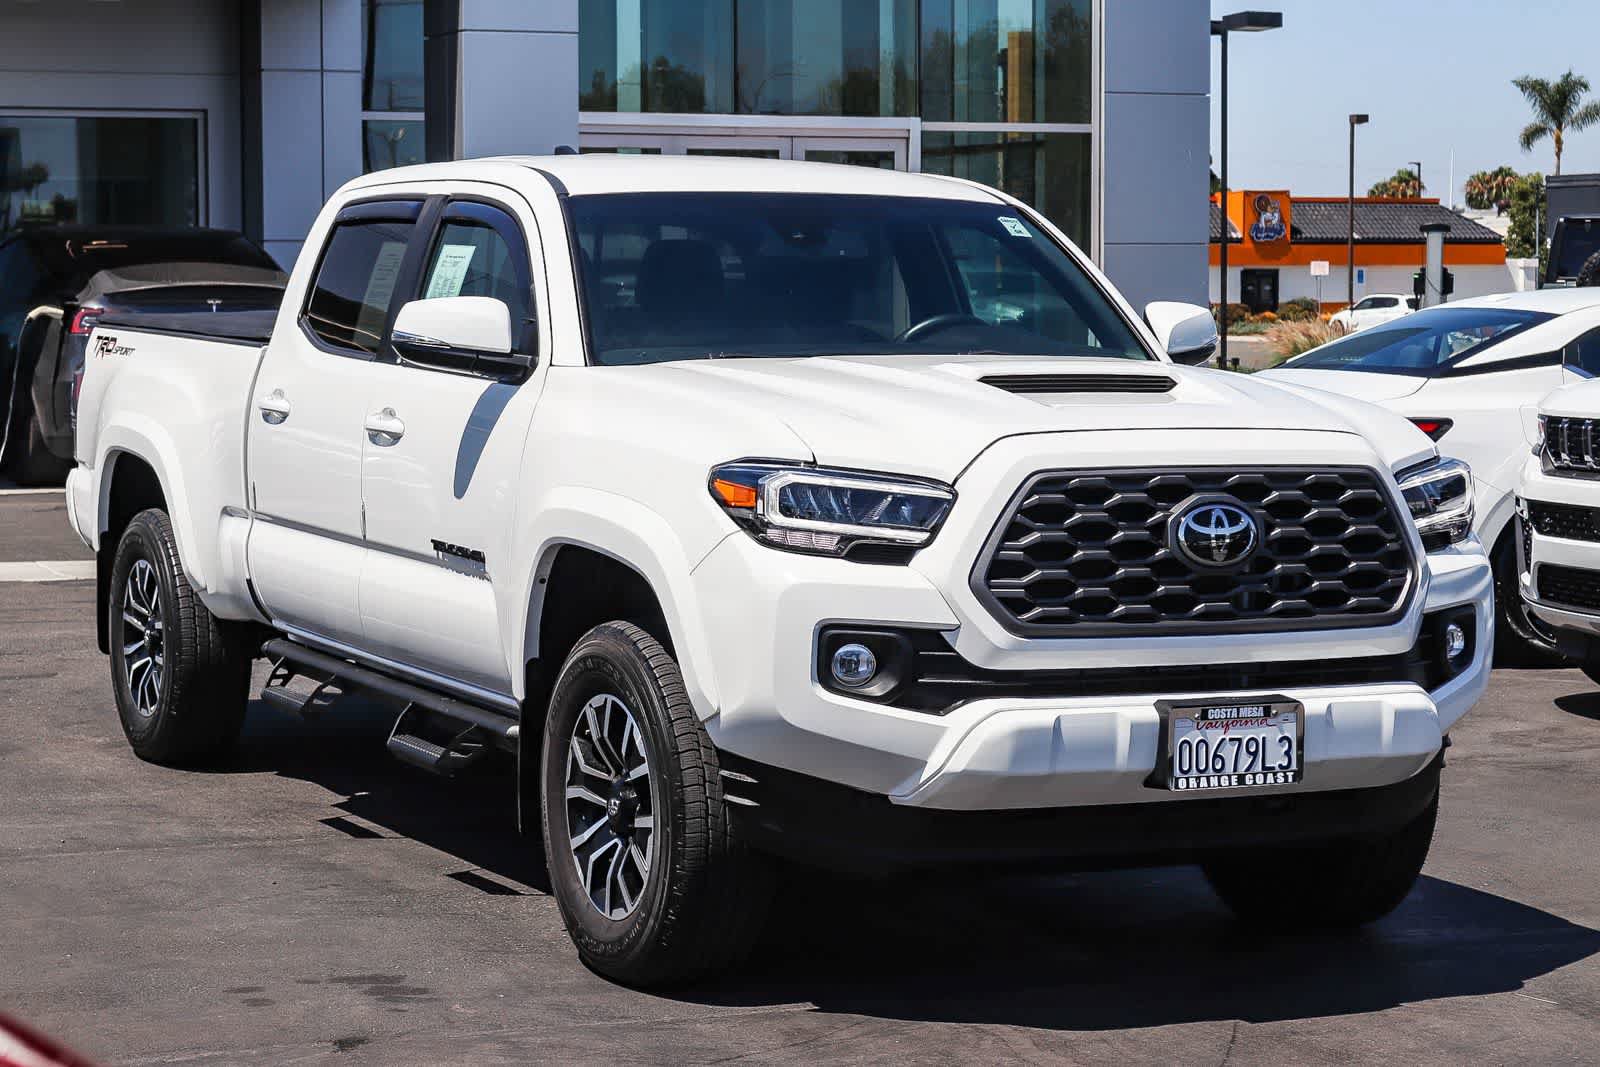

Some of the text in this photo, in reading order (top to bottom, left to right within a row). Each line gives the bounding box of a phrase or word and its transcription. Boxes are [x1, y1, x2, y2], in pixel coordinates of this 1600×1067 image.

[95, 335, 117, 359] TRD
[1207, 706, 1264, 719] COSTA MESA
[1178, 735, 1293, 775] 00679L3
[1178, 772, 1294, 789] ORANGE COAST
